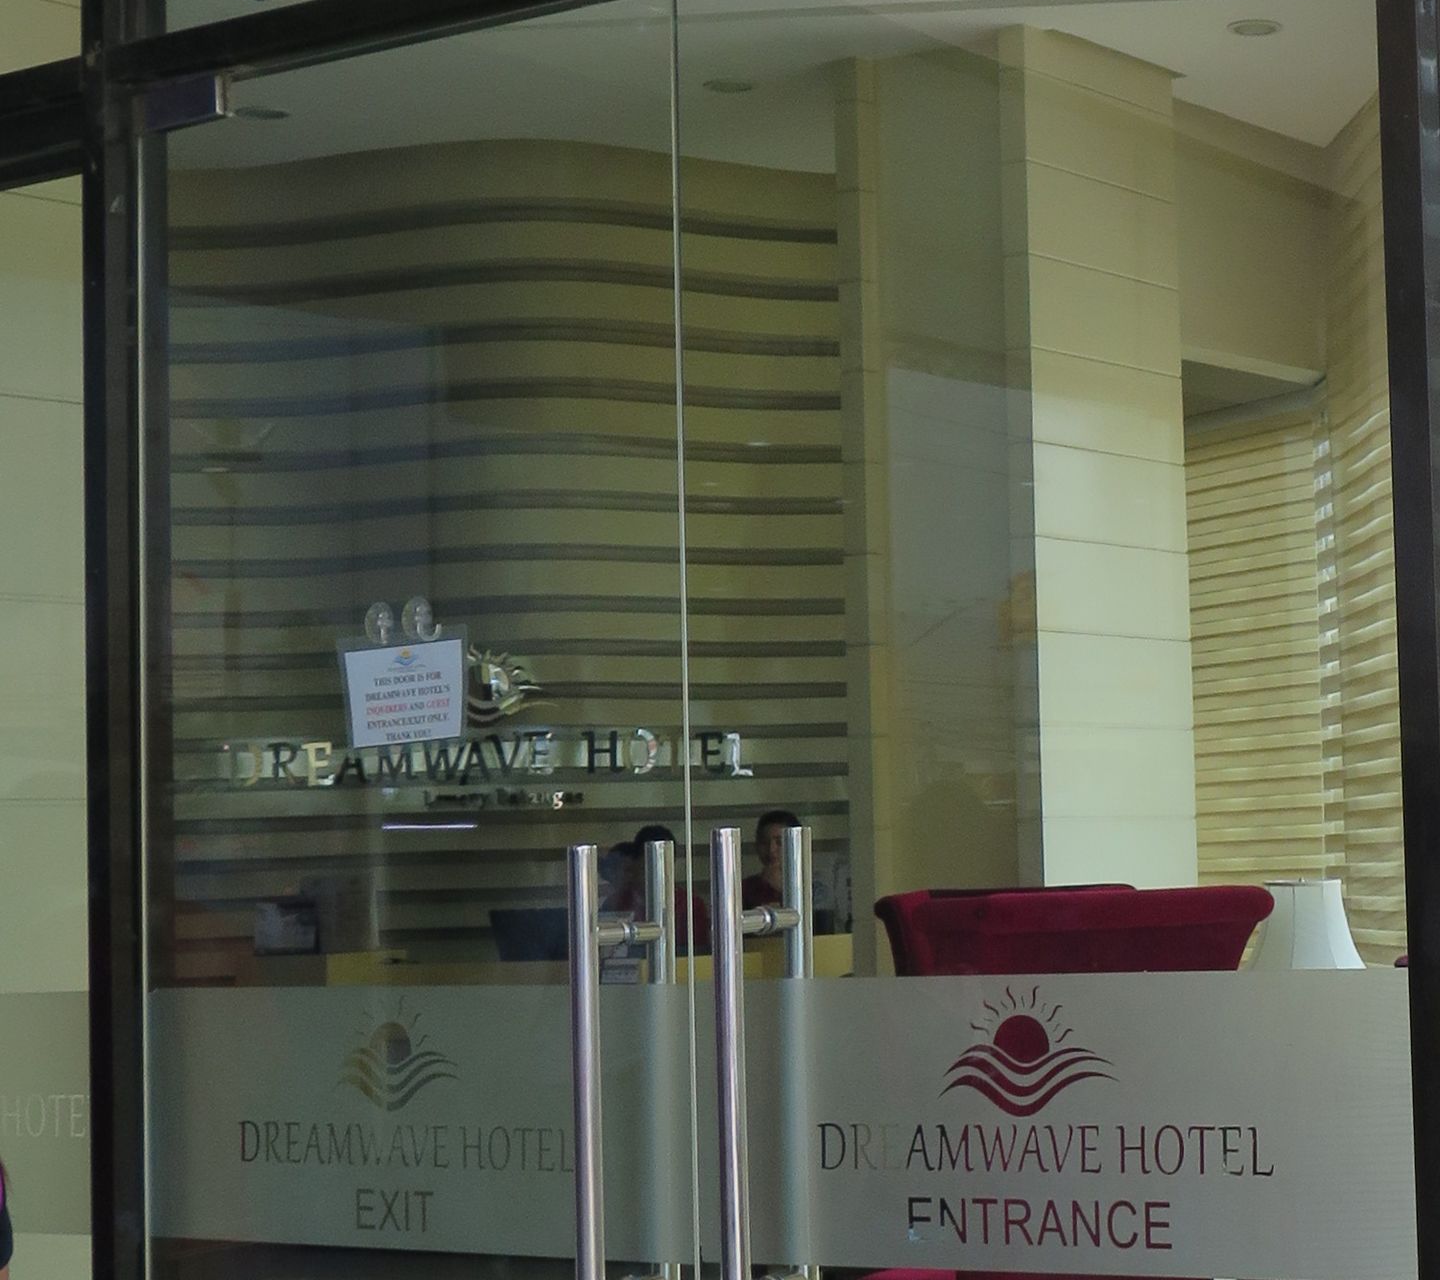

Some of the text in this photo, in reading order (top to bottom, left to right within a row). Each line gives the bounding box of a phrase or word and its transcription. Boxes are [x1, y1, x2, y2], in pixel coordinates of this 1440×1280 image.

[374, 676, 392, 687] THIS
[426, 671, 441, 681] FOR
[224, 730, 553, 787] DREAMWAVE
[0, 1094, 90, 1137] HOTE
[237, 1119, 574, 1173] DREAMWAVE HOTEL
[817, 1122, 1274, 1177] DREAMWAVE HOTEL
[356, 1188, 434, 1232] EXIT
[907, 1196, 1173, 1250] ENTRANCE
